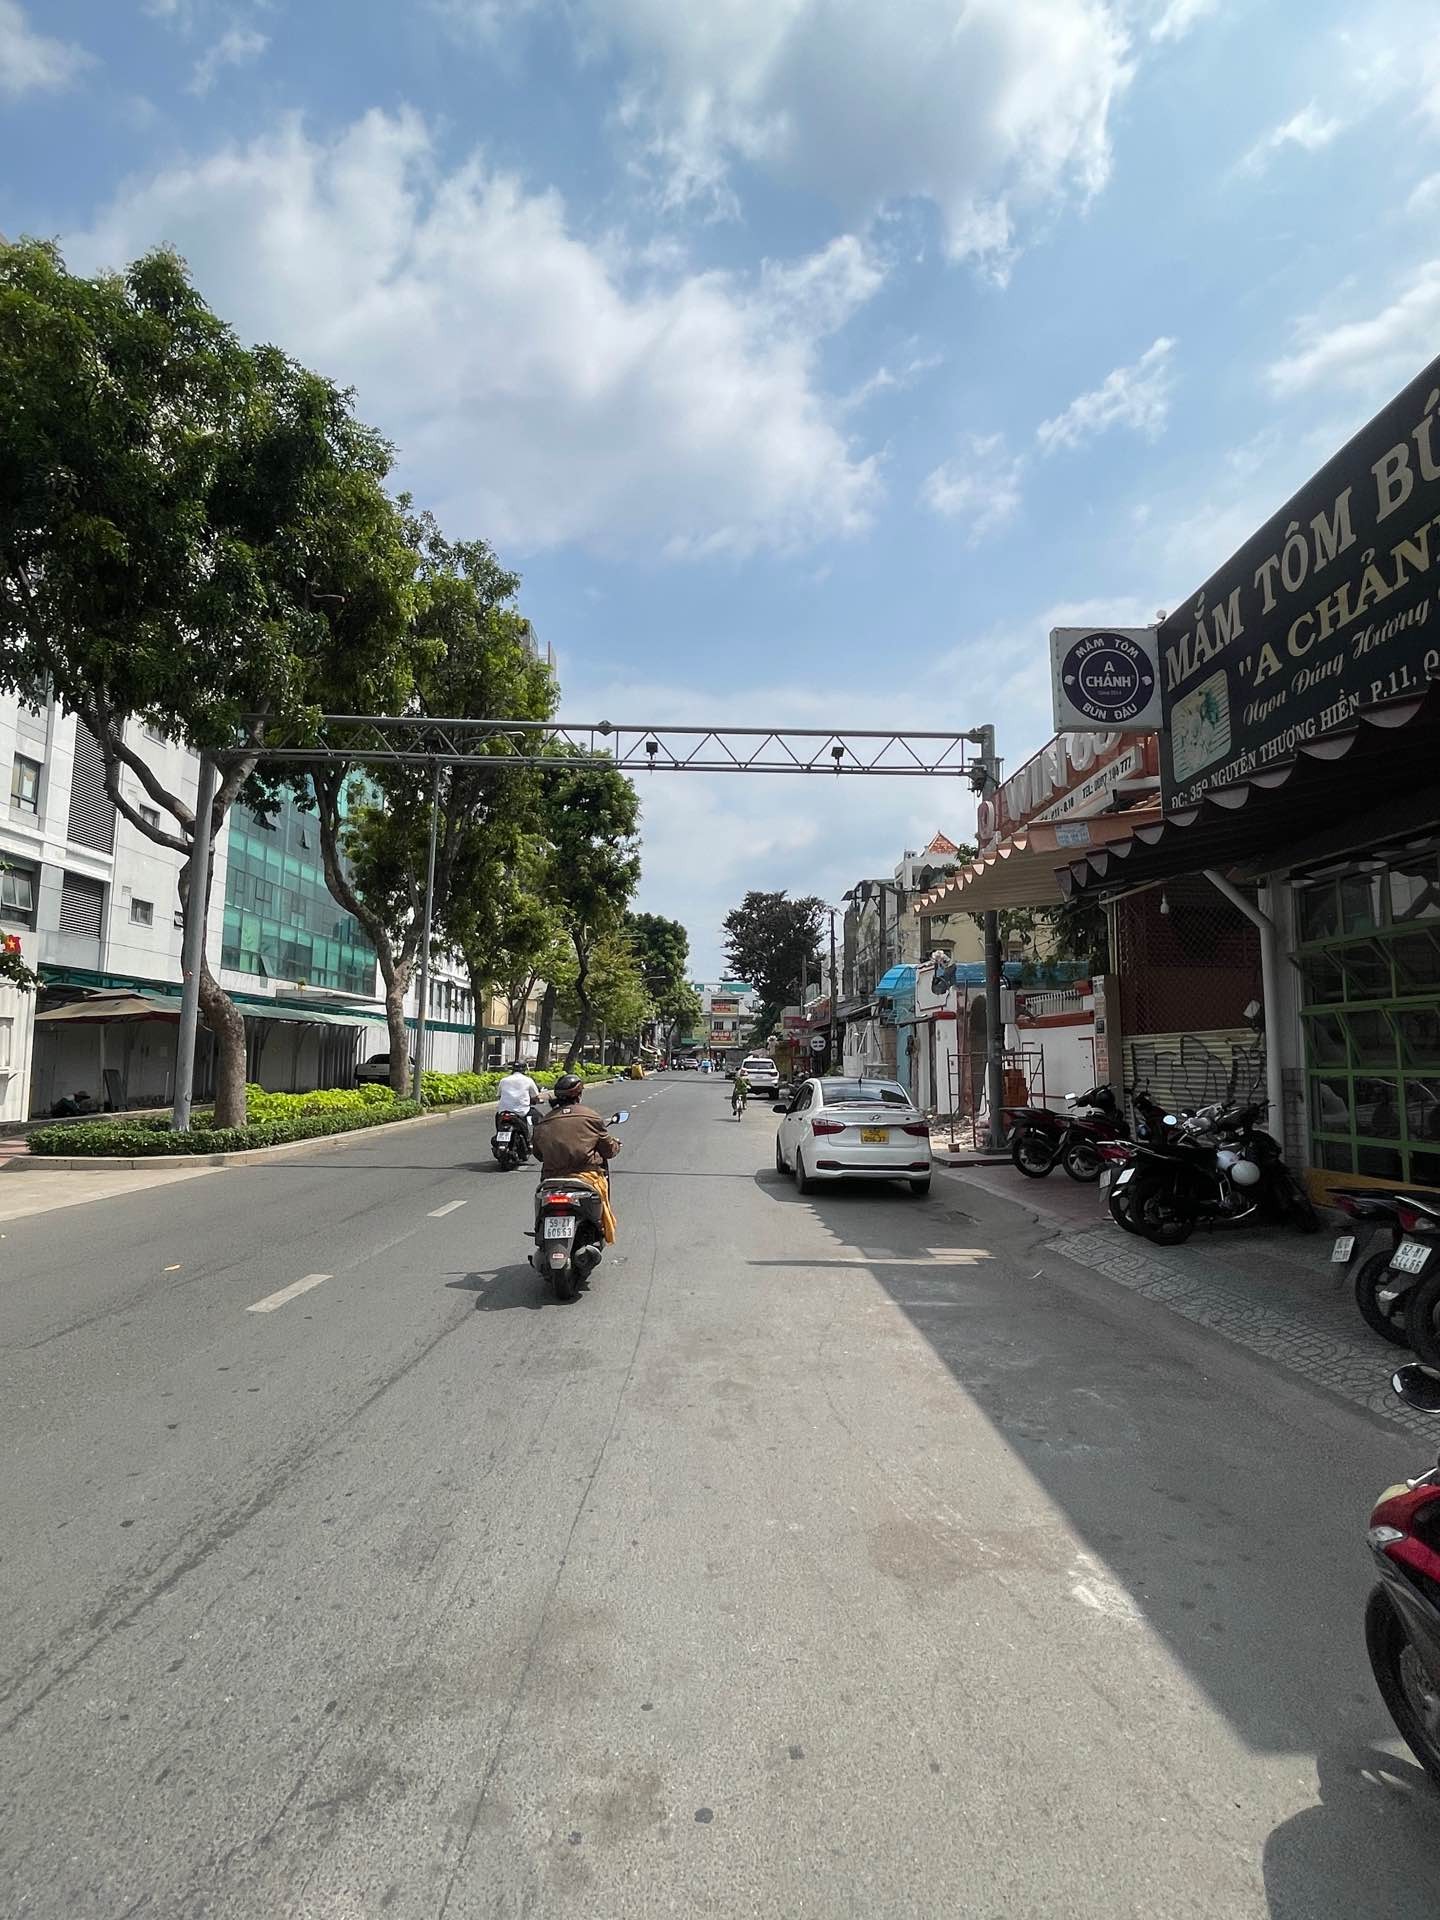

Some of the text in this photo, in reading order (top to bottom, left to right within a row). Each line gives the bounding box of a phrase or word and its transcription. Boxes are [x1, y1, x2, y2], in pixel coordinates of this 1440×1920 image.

[1165, 591, 1245, 692] MẮM
[1254, 486, 1357, 616] TÔM
[1287, 514, 1440, 657] CHẢN
[1085, 672, 1131, 687] CHẢNH
[1104, 660, 1115, 672] A
[1114, 638, 1139, 658] TÔM
[1210, 747, 1257, 787] NGUYỄN
[1260, 717, 1317, 763] THƯỢNG
[1319, 688, 1360, 731] HIỀN
[1371, 665, 1417, 703] P.11,
